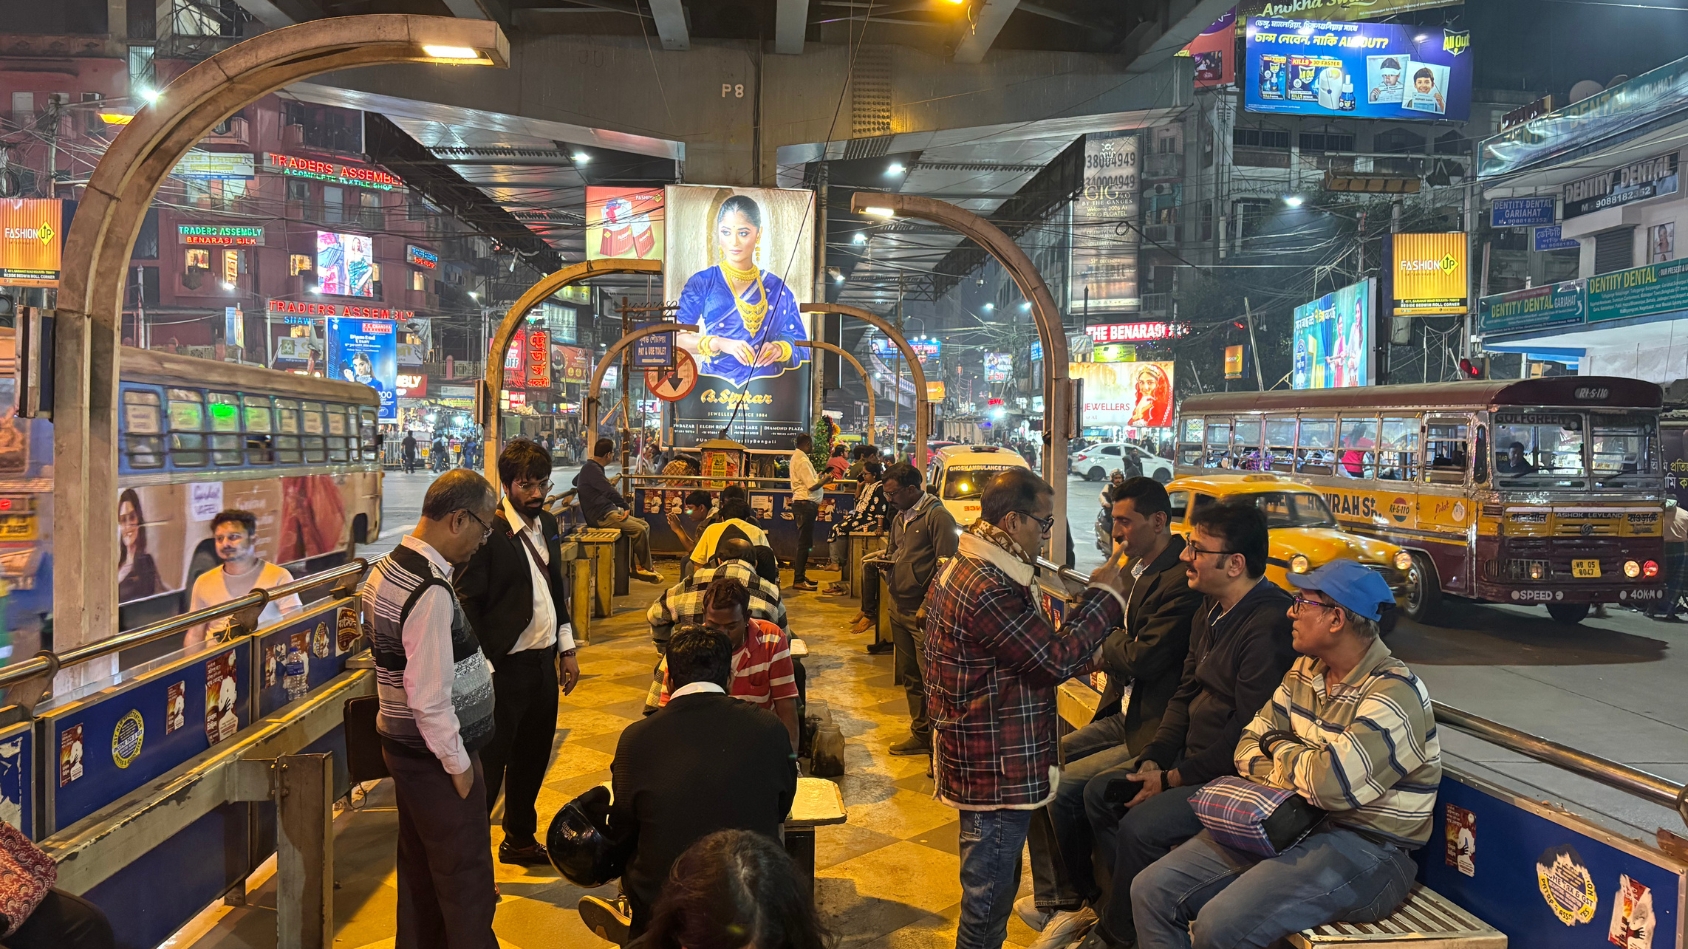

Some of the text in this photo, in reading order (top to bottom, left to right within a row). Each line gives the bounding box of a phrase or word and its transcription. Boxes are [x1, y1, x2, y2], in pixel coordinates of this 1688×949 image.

[269, 153, 404, 186] TRADERS ASSEMBL
[1565, 155, 1674, 204] DENTITY DENTAL
[1495, 199, 1553, 210] DENTITY DENTAL
[1504, 208, 1542, 218] GARIAHAT
[5, 225, 52, 239] FASHION UP
[179, 226, 262, 237] TRADERS ASSEMBLY
[186, 236, 257, 245] BENARASI SILK
[1400, 256, 1455, 271] FASHION UP
[1590, 273, 1622, 295] DENTITY
[1623, 266, 1657, 288] DENTAL
[269, 300, 336, 316] TRADERS
[1491, 300, 1522, 318] DENTITY
[1524, 295, 1553, 313] DENTAL
[1086, 326, 1108, 340] THE
[1084, 402, 1130, 411] JEWELLERS
[1495, 414, 1566, 425] GOLFGREEN
[1519, 590, 1553, 600] SPEED
